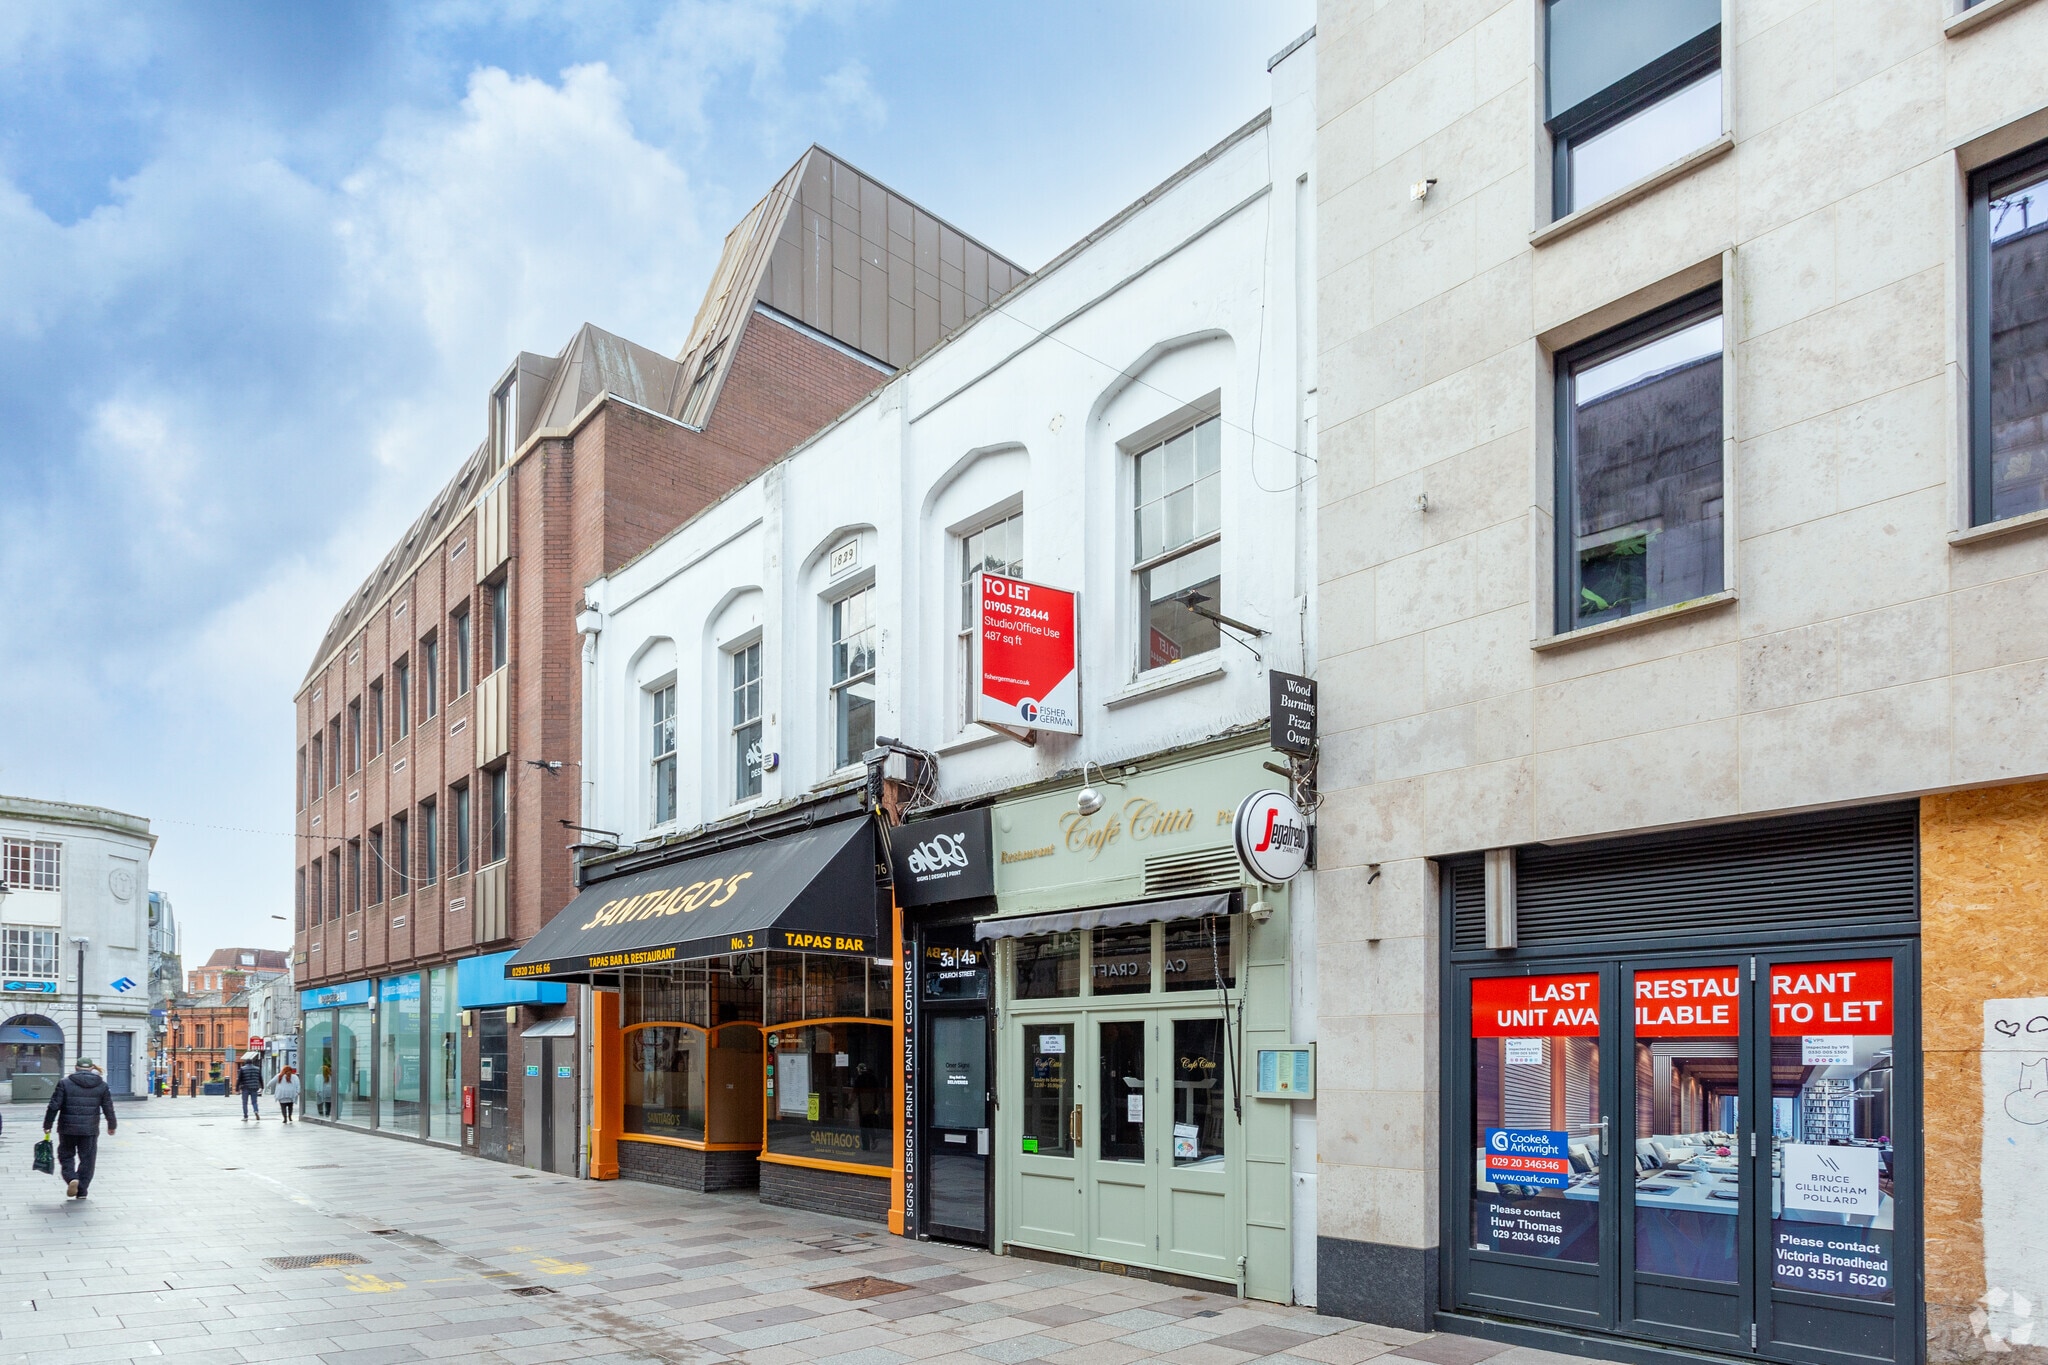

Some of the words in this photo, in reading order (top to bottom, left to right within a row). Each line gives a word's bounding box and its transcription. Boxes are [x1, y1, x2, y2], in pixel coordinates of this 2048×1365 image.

[833, 549, 854, 568] 1829
[984, 578, 1005, 596] TO
[1008, 583, 1030, 601] LET
[984, 600, 1012, 614] 01905
[1014, 605, 1049, 621] 728444
[984, 616, 1042, 635] Studio/Office
[1043, 627, 1060, 639] Use
[984, 631, 1001, 641] 487
[1003, 636, 1014, 646] sq
[1015, 635, 1022, 645] ft
[1286, 679, 1311, 698] Wood
[1040, 706, 1066, 717] FISHER
[1280, 694, 1316, 716] Burning
[1040, 714, 1073, 727] GERMAN
[1287, 714, 1311, 730] Pizza
[1286, 730, 1310, 746] Oven
[1254, 807, 1306, 853] Segafredo
[1000, 843, 1055, 864] Restaurant
[931, 873, 946, 881] DESIGN
[581, 871, 753, 931] SANTIAGO'S
[731, 937, 746, 950] No.
[747, 935, 754, 948] 3
[785, 932, 832, 949] TAPAS
[835, 937, 865, 952] BAR
[589, 957, 609, 968] TAPAS
[610, 955, 623, 966] BAR
[623, 954, 630, 965] &
[630, 948, 676, 964] RESTAURANT
[940, 952, 954, 967] 3a
[961, 950, 976, 965] 4a
[940, 971, 958, 979] CHURCH
[958, 970, 976, 978] STREET
[904, 961, 913, 1025] CLOTHING
[1531, 982, 1590, 1002] LAST
[1635, 977, 1740, 1000] RESTAU
[1773, 971, 1857, 995] RANT
[1497, 1009, 1548, 1027] UNIT
[1552, 1008, 1599, 1027] AVA
[1635, 1005, 1729, 1025] ILABLE
[1773, 1002, 1814, 1023] TO
[1823, 1001, 1882, 1022] LET
[905, 1036, 913, 1071] PAINT
[905, 1083, 913, 1118] PRINT
[810, 1130, 860, 1149] SANTIAGO'S
[906, 1129, 914, 1173] DESIGN
[1510, 1143, 1559, 1156] Arkwright
[1492, 1157, 1508, 1167] 029
[1511, 1158, 1522, 1168] 20
[1524, 1160, 1559, 1170] 346346
[1492, 1173, 1559, 1185] www.coark.com
[1811, 1174, 1850, 1184] BRUCE
[1795, 1183, 1867, 1195] GILLINGHAM
[906, 1182, 914, 1218] SIGNS
[1803, 1193, 1858, 1205] POLLARD
[1490, 1204, 1521, 1215] Please
[1523, 1209, 1561, 1219] contact
[1490, 1216, 1514, 1228] Huw
[1517, 1219, 1563, 1233] Thomas
[1493, 1229, 1509, 1239] 029
[1511, 1232, 1534, 1242] 2034
[1536, 1235, 1560, 1245] 6346
[1780, 1234, 1824, 1248] Please
[1827, 1240, 1880, 1254] contact
[1776, 1248, 1819, 1264] Victoria
[1822, 1253, 1888, 1272] Broadhead
[1777, 1264, 1804, 1278] 020
[1807, 1267, 1843, 1282] 3551
[1849, 1272, 1887, 1288] 5620
